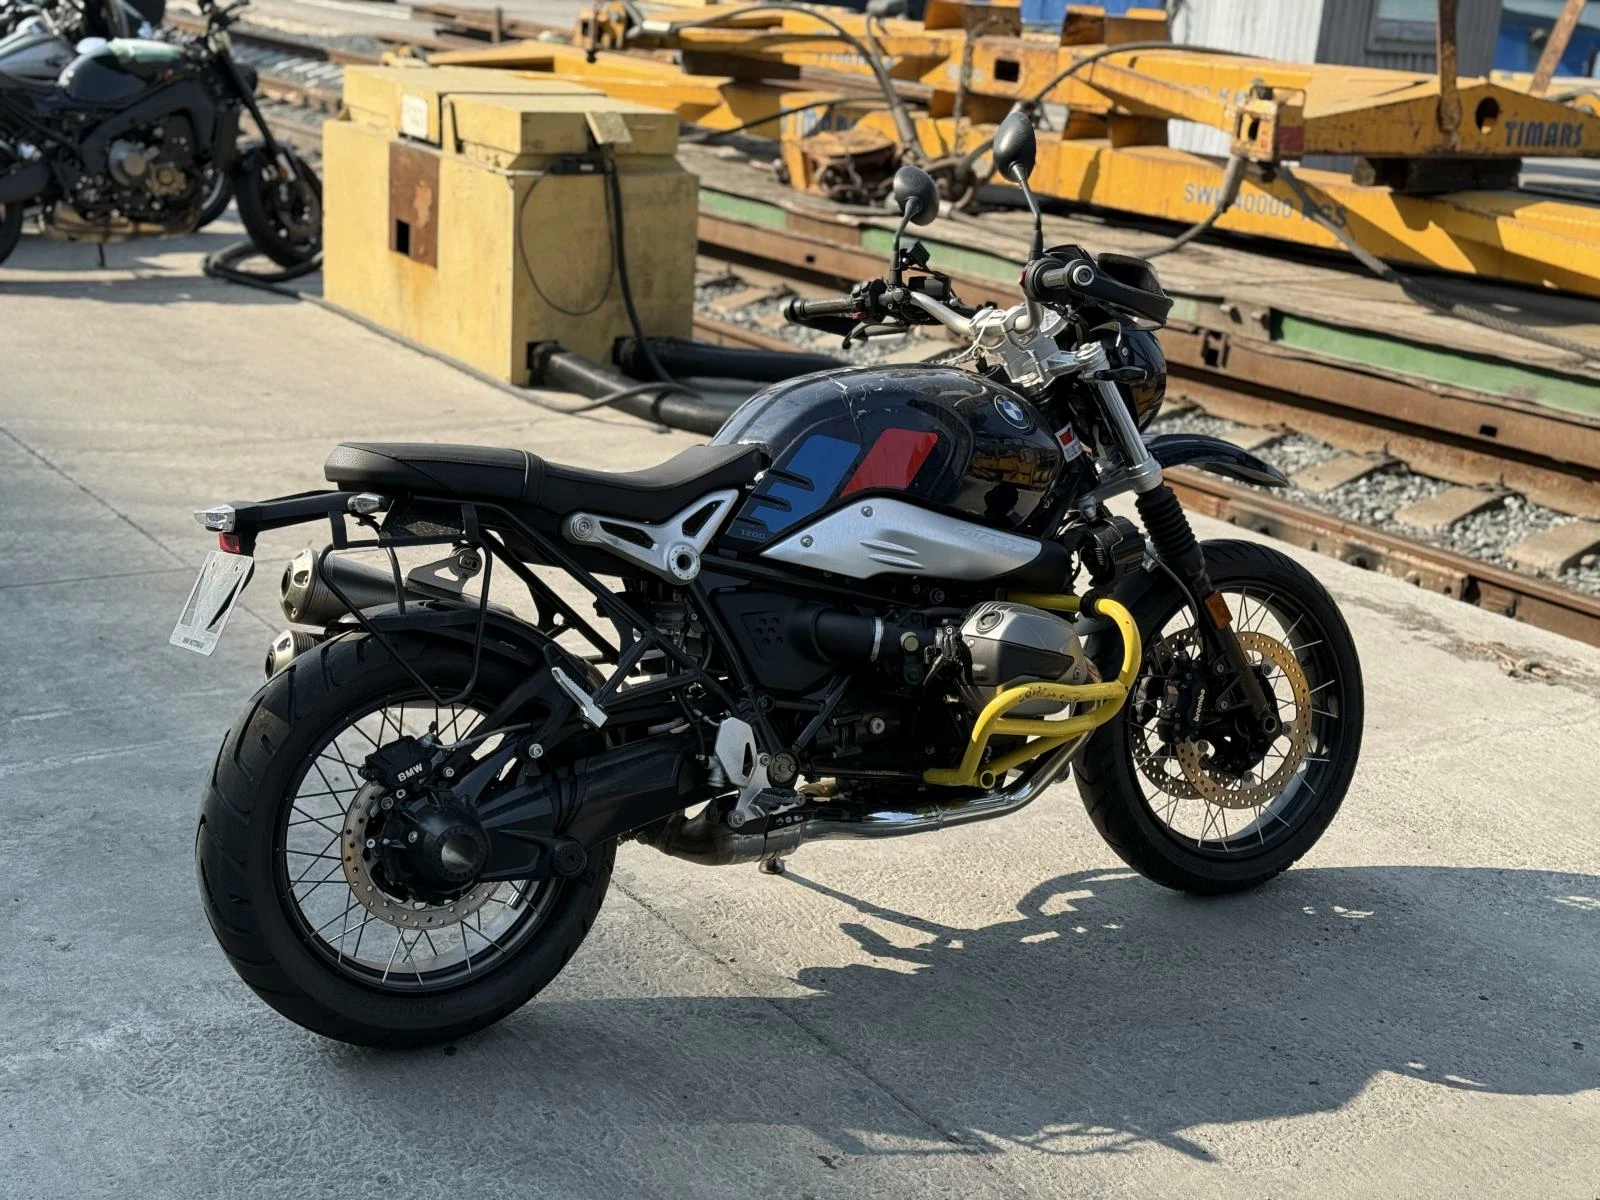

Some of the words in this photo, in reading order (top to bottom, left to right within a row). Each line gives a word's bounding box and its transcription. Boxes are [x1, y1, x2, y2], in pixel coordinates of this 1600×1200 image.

[1504, 121, 1584, 148] TIMARS
[741, 529, 766, 541] 1200
[1193, 689, 1206, 722] brembo
[397, 763, 423, 781] BMW
